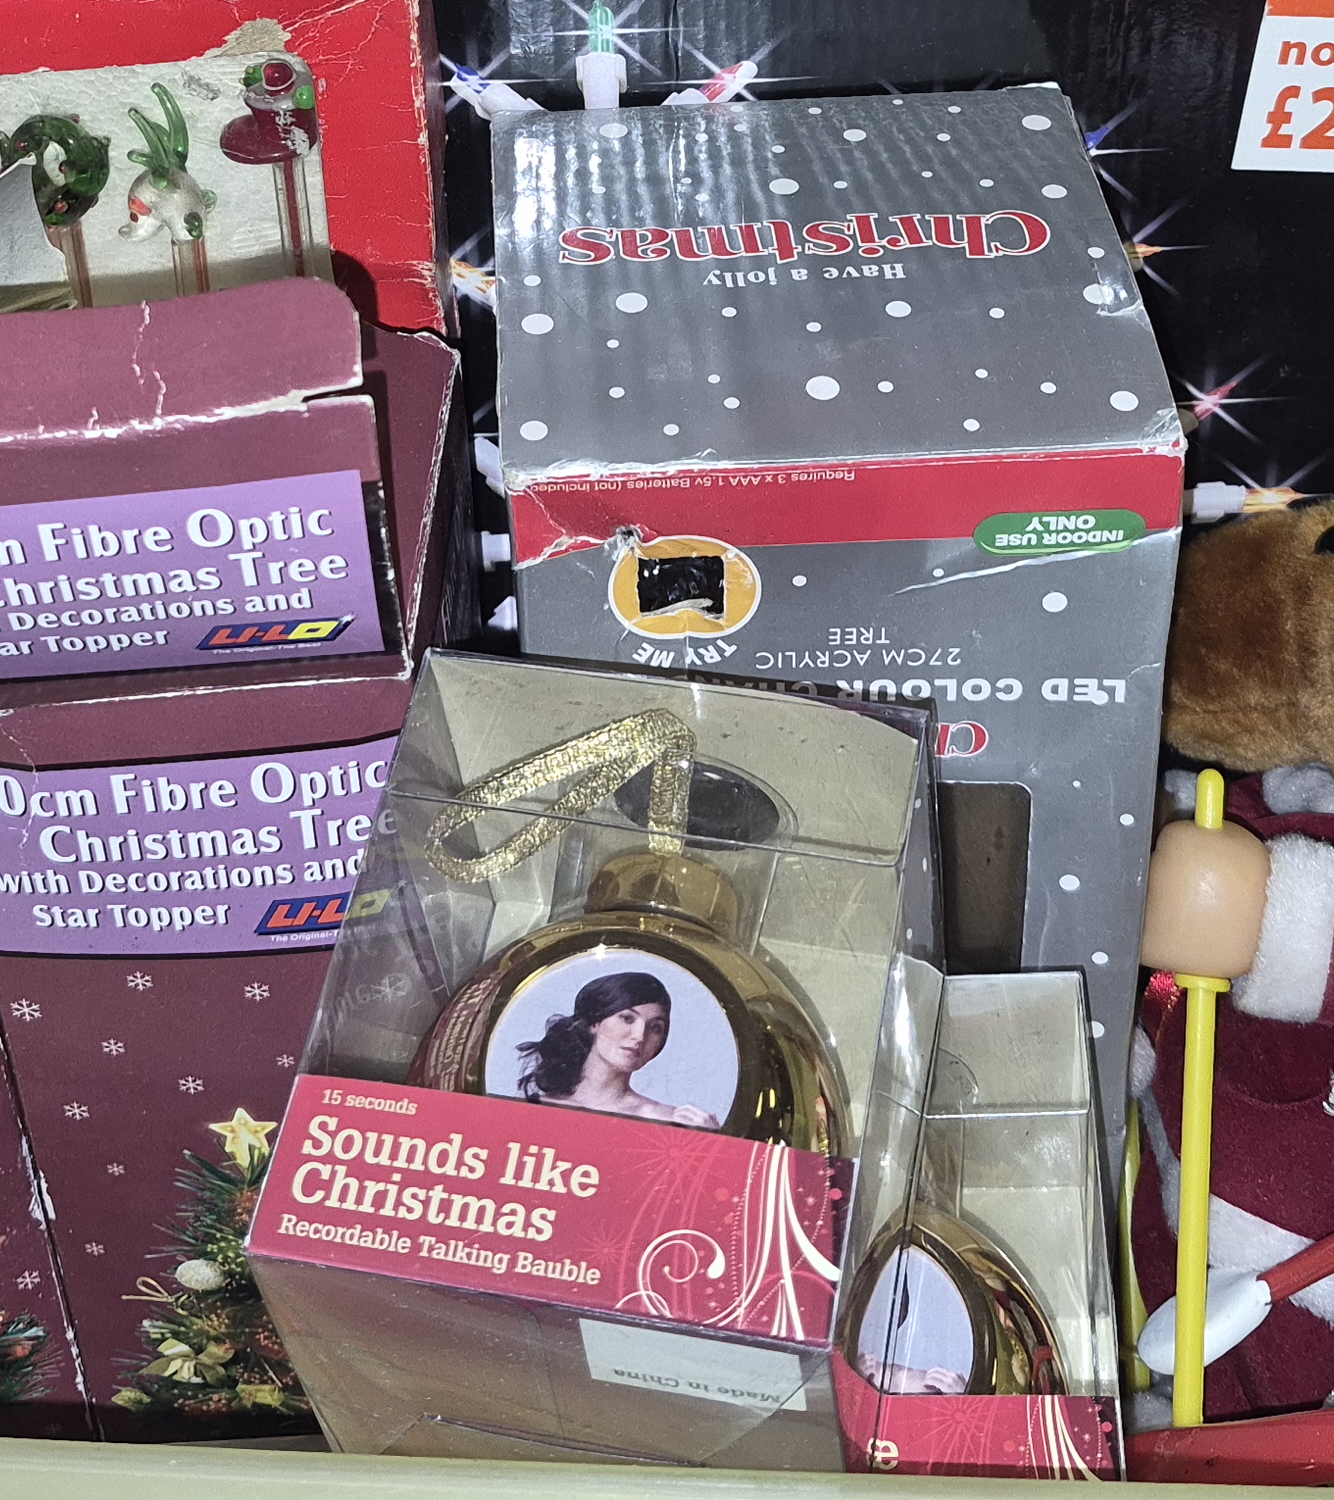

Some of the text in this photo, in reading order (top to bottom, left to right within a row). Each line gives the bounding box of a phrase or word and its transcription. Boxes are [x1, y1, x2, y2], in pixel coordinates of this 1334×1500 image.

[559, 210, 1051, 266] Christmas
[703, 264, 906, 287] Have a jolly
[594, 480, 622, 492] (not
[627, 477, 690, 489] Batteries
[729, 474, 760, 485] AAA
[765, 475, 774, 483] x
[778, 474, 786, 483] 3
[791, 471, 855, 482] Requires
[36, 523, 173, 563] Fibre
[186, 507, 334, 549] Optic
[1025, 515, 1096, 531] ONLY
[995, 530, 1124, 546] INDOOR USE
[228, 552, 348, 588] Tree
[8, 597, 235, 632] Decorations
[244, 588, 312, 611] and
[40, 628, 169, 653] Topper
[828, 628, 890, 645] TREE
[632, 638, 738, 668] TRY ME
[755, 646, 962, 669] 27CM ACRYLIC
[1042, 678, 1127, 705] LED
[110, 773, 236, 814] Fibre
[250, 760, 388, 806] Optic
[39, 808, 398, 864] Christmas Tree
[79, 860, 293, 895] Decorations
[303, 849, 367, 882] and
[32, 903, 229, 931] Star Topper
[322, 1088, 418, 1115] 15 seconds
[301, 1115, 600, 1198] Sounds like
[291, 1161, 556, 1242] Christmas
[278, 1213, 601, 1285] Recordable Talking Bauble
[612, 1367, 780, 1404] Made in China
